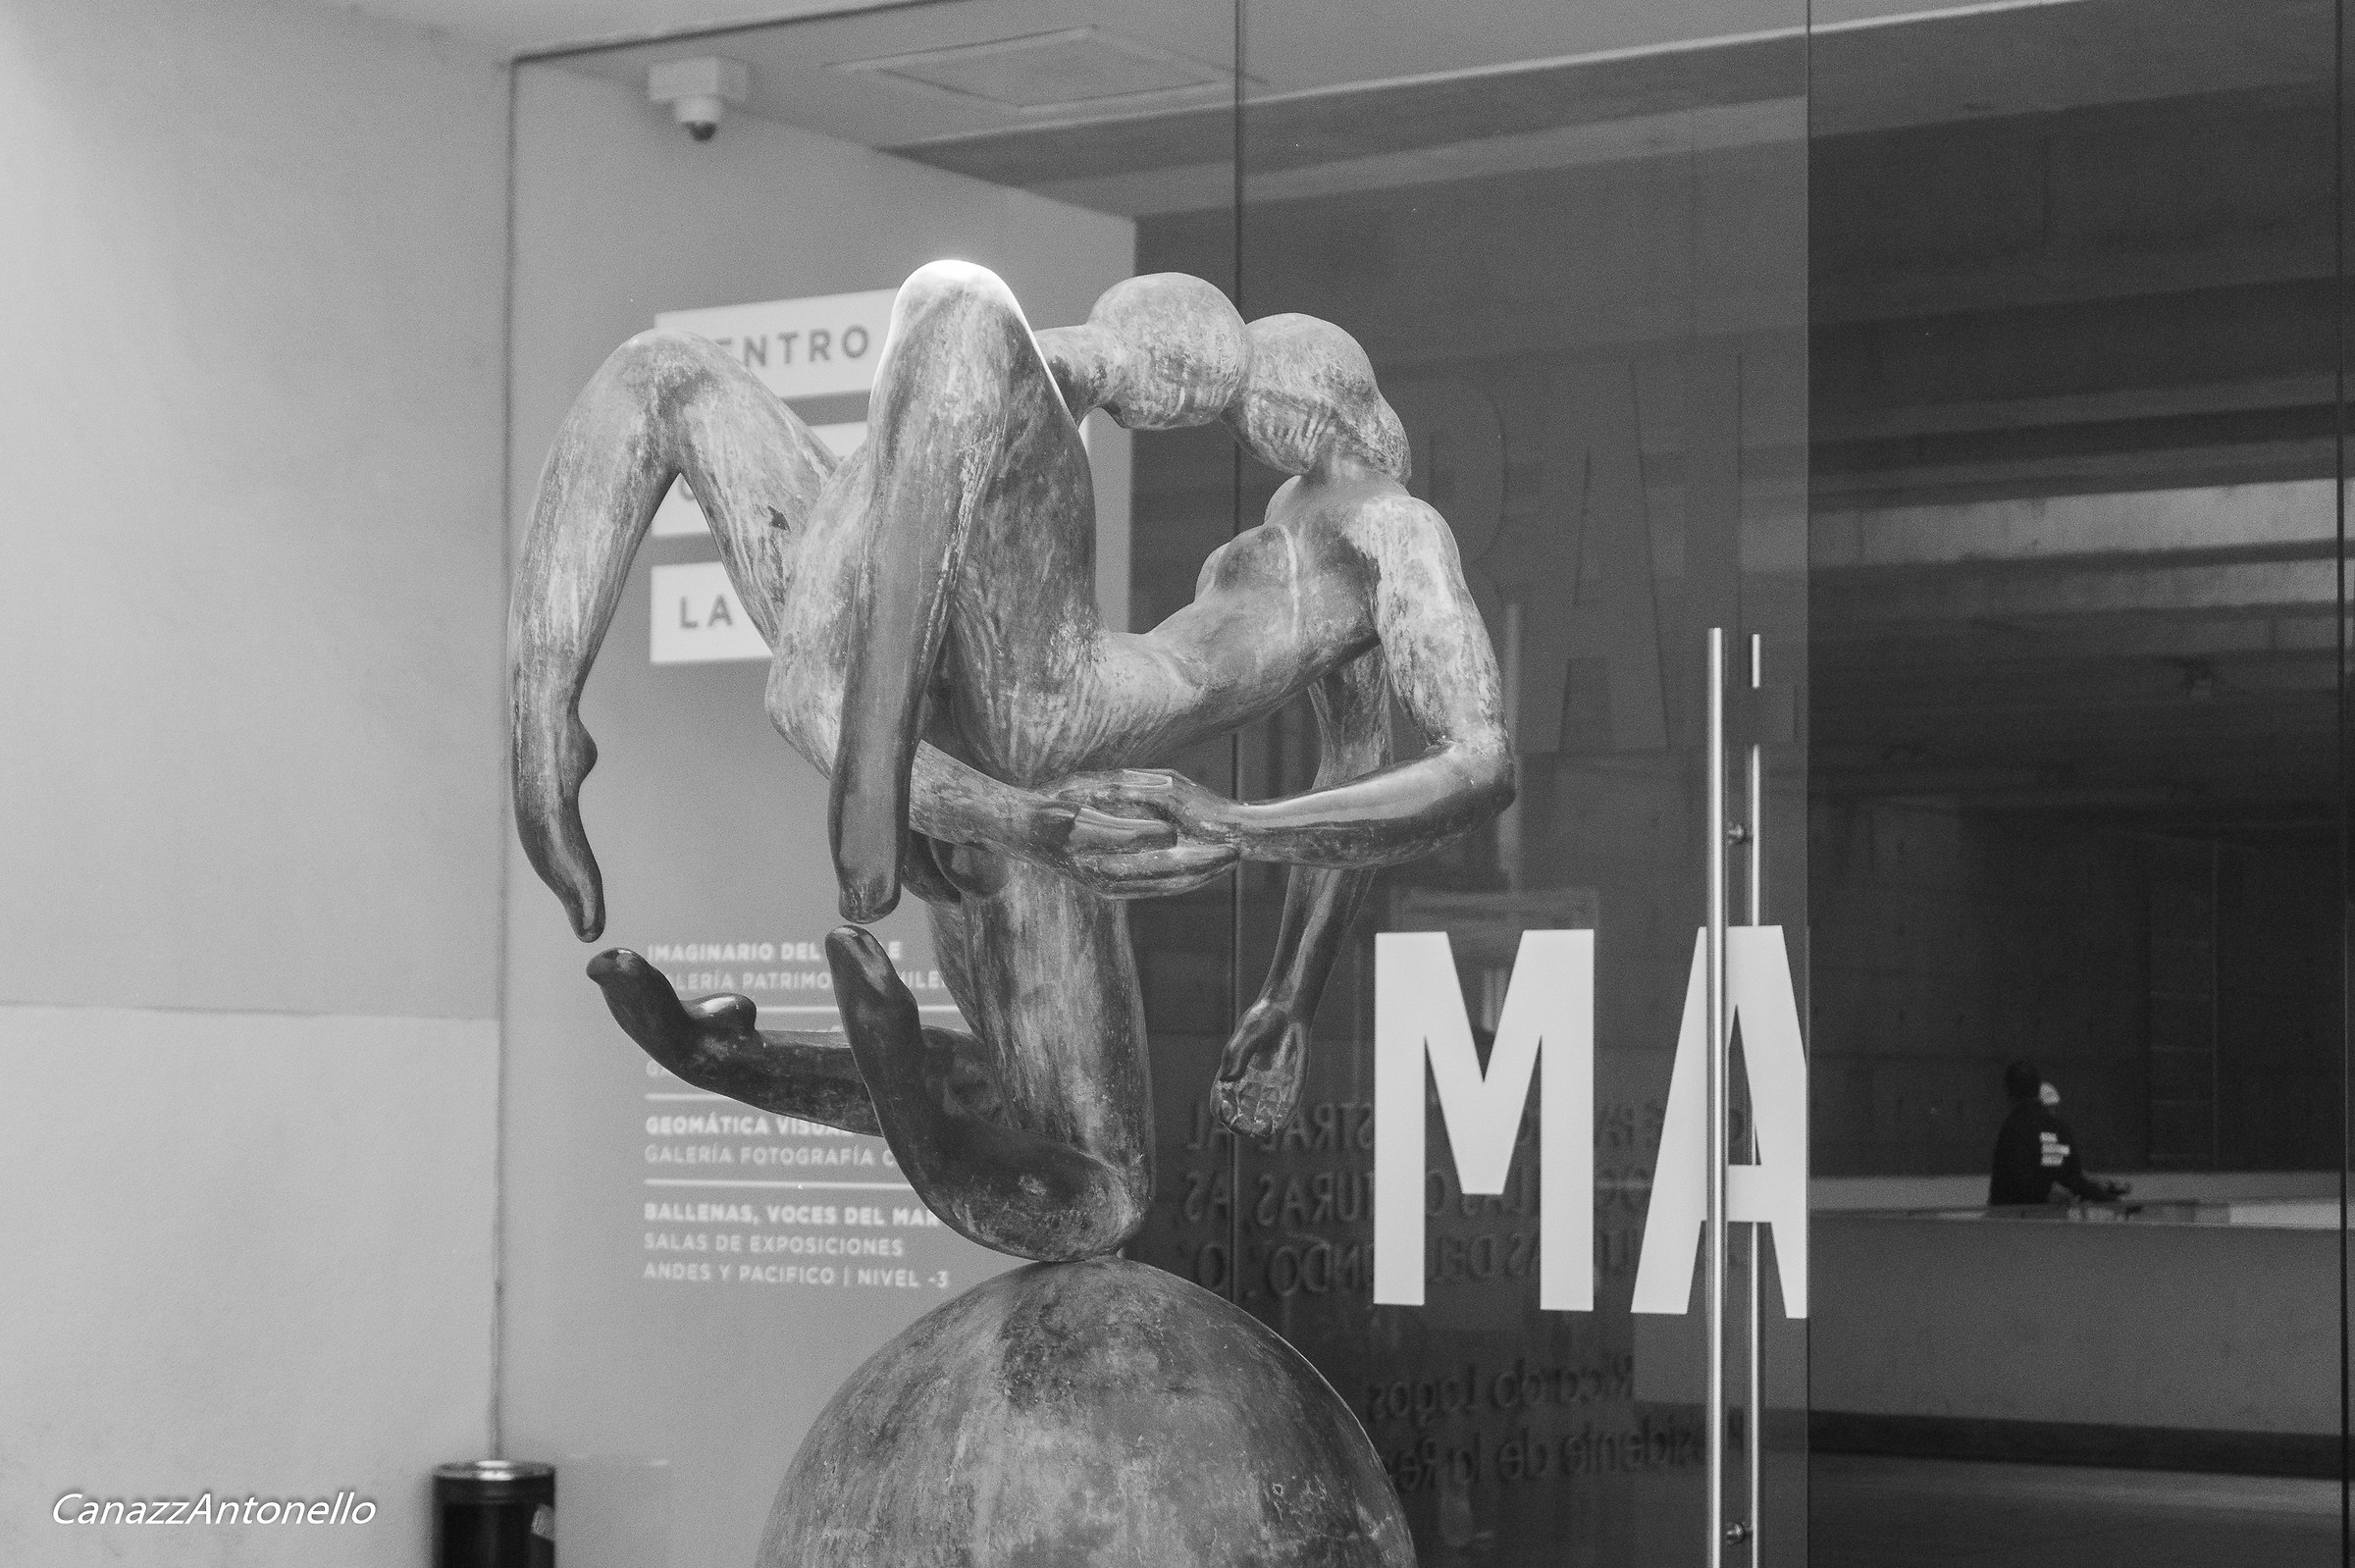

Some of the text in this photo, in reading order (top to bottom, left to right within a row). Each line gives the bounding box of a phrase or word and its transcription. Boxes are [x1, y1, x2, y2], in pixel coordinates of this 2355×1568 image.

[716, 324, 870, 368] NTRO
[679, 595, 734, 628] LA
[647, 942, 820, 962] IMAGINARIO DEL
[675, 968, 734, 990] LERÍA
[743, 970, 832, 990] PATRIMO
[645, 1112, 769, 1135] GEOMÁTICA
[1374, 924, 1807, 1319] MA
[644, 1143, 734, 1165] GALERÍA
[740, 1144, 874, 1166] FOTOGRAFÍA
[644, 1202, 759, 1225] BALLENAS,
[765, 1205, 836, 1225] VOCES
[844, 1206, 885, 1226] DEL
[644, 1232, 904, 1257] SALAS DE EXPOSICIONES
[644, 1262, 711, 1281] ANDES
[718, 1264, 731, 1281] Y
[858, 1268, 920, 1288] NIVEL
